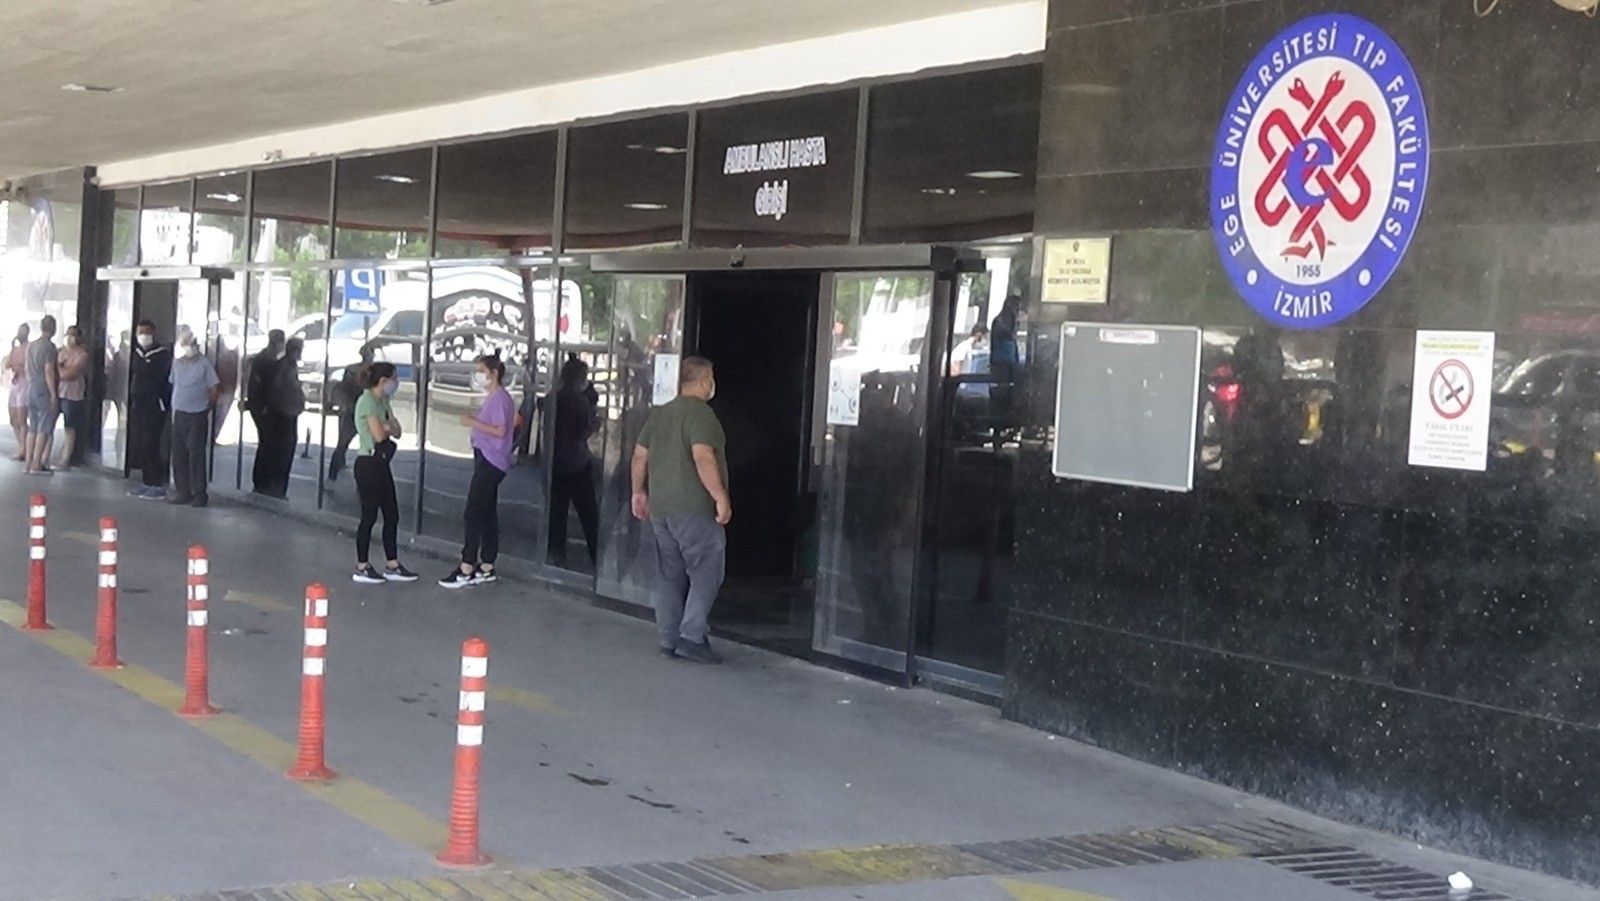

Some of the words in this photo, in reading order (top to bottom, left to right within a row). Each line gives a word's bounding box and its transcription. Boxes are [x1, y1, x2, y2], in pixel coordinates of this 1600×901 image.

[1352, 34, 1388, 69] TIP
[1218, 21, 1338, 167] ÜNİVERSİTESİ
[789, 136, 827, 168] HASTA
[1379, 75, 1422, 253] FAKÜLTESİ
[1220, 193, 1246, 257] EGE
[1295, 265, 1322, 278] 1955
[1273, 284, 1333, 319] İZMİR
